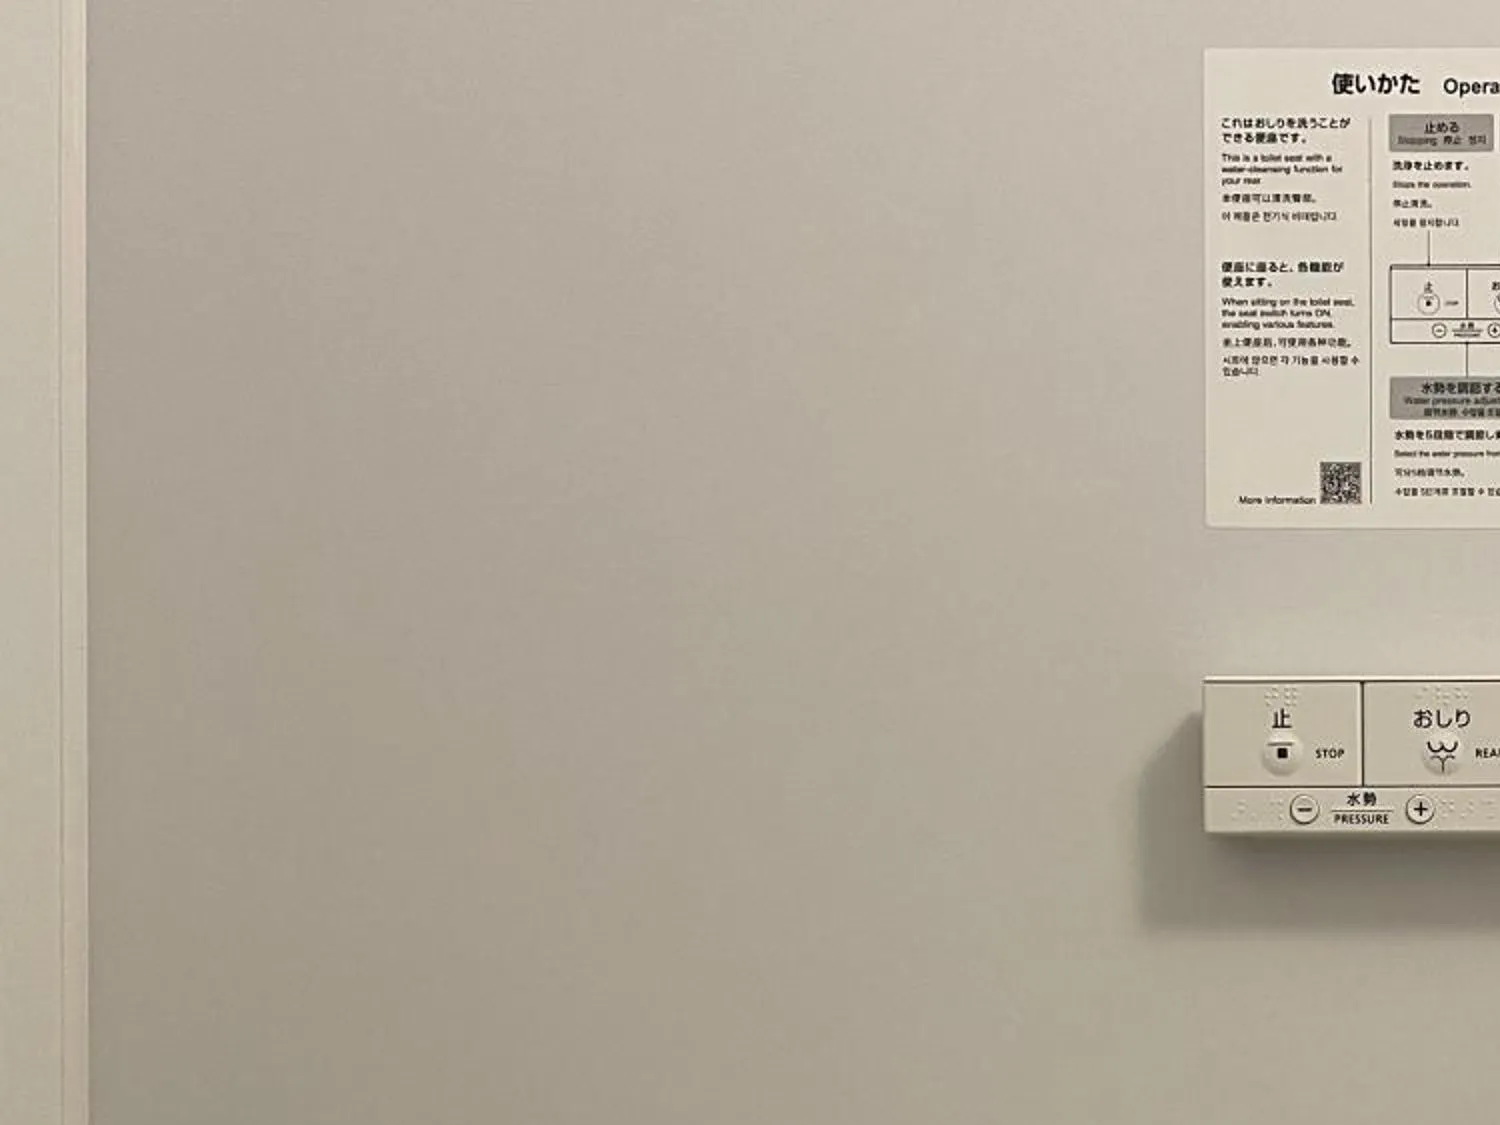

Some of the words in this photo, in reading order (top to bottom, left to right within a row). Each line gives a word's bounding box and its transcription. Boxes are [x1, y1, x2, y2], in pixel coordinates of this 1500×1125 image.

[1332, 73, 1420, 94] 使いかた
[1424, 122, 1460, 134] 止める
[1272, 708, 1292, 728] 止
[1414, 709, 1470, 728] おしり
[1316, 748, 1344, 758] STOP
[1347, 792, 1376, 806] 水勢
[1334, 814, 1389, 824] PRESSURE
